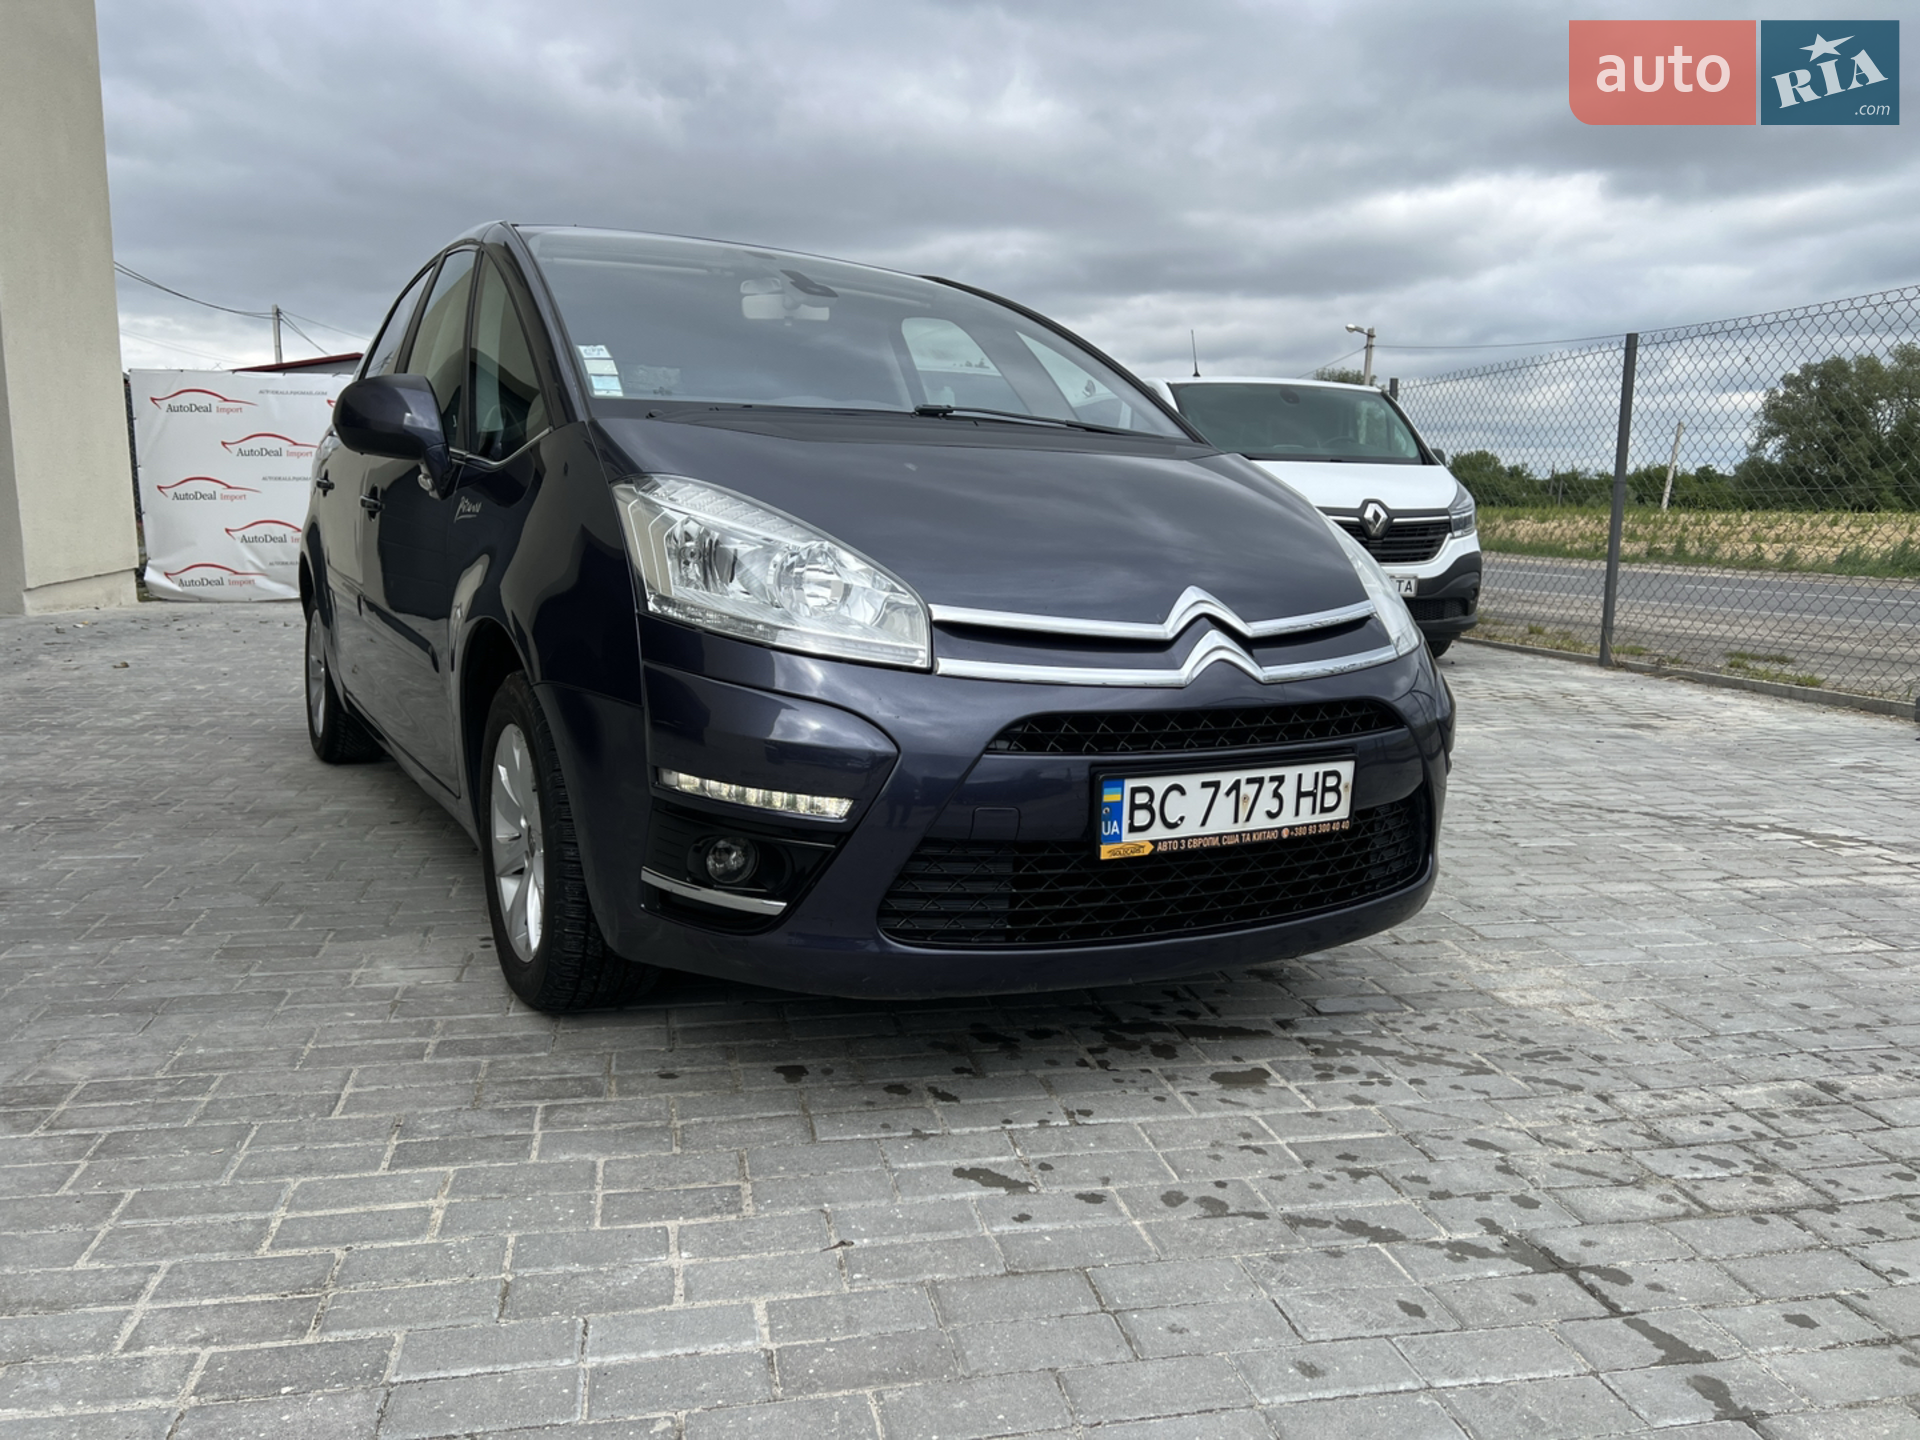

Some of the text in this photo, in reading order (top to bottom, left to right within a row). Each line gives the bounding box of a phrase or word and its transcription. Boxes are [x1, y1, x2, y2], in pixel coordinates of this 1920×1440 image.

[166, 403, 243, 414] AutoDeal Import
[236, 447, 313, 459] AutoDeal Import
[171, 491, 247, 502] AutoDeal Import
[240, 534, 287, 544] AutoDeal
[177, 577, 255, 587] AutoDeal Import
[1396, 580, 1413, 592] TA
[1128, 769, 1342, 833] BC 7173 HB
[1102, 820, 1120, 835] UA
[1157, 840, 1178, 852] АВТО
[1222, 834, 1239, 845] США
[1241, 832, 1251, 843] ТА
[1252, 830, 1279, 841] КИТАЮ
